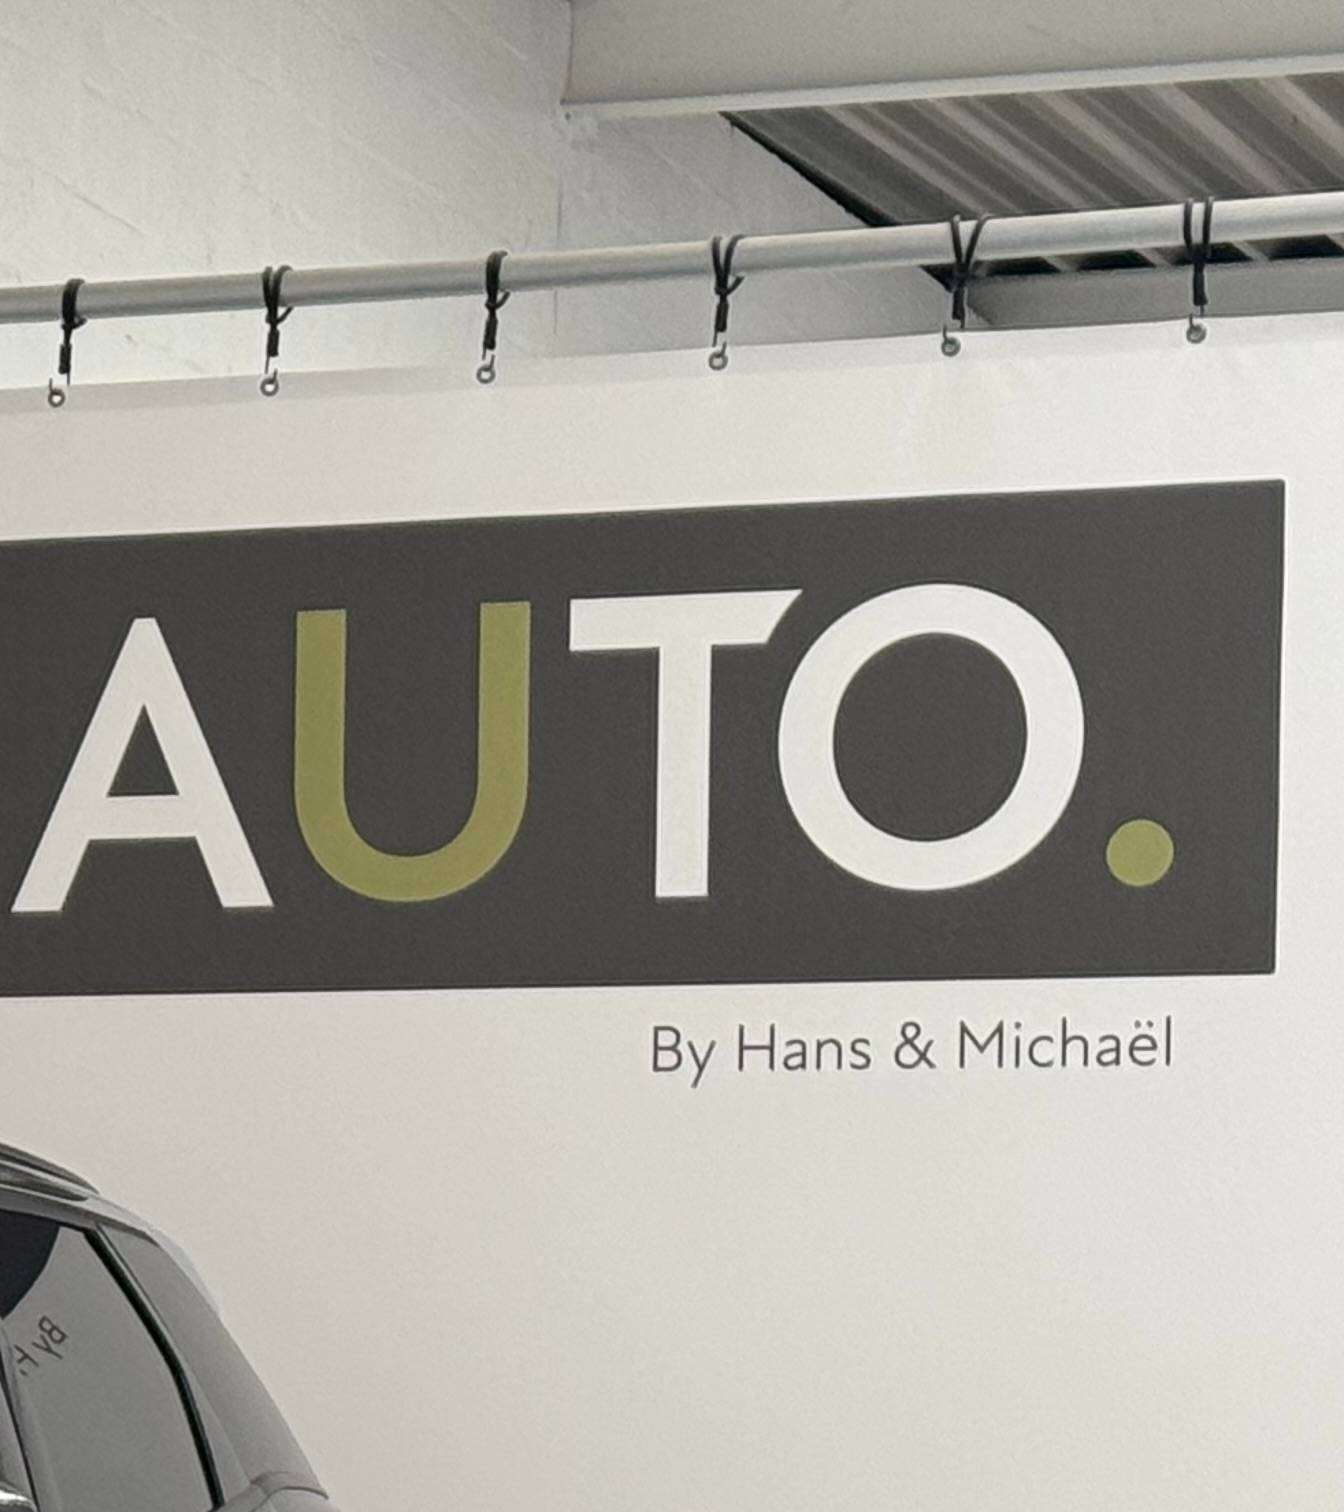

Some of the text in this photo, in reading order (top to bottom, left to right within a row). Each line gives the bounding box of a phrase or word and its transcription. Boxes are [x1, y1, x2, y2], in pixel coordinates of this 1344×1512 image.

[11, 583, 1174, 913] AUTO.
[653, 1016, 1171, 1088] By Hans & Michaël
